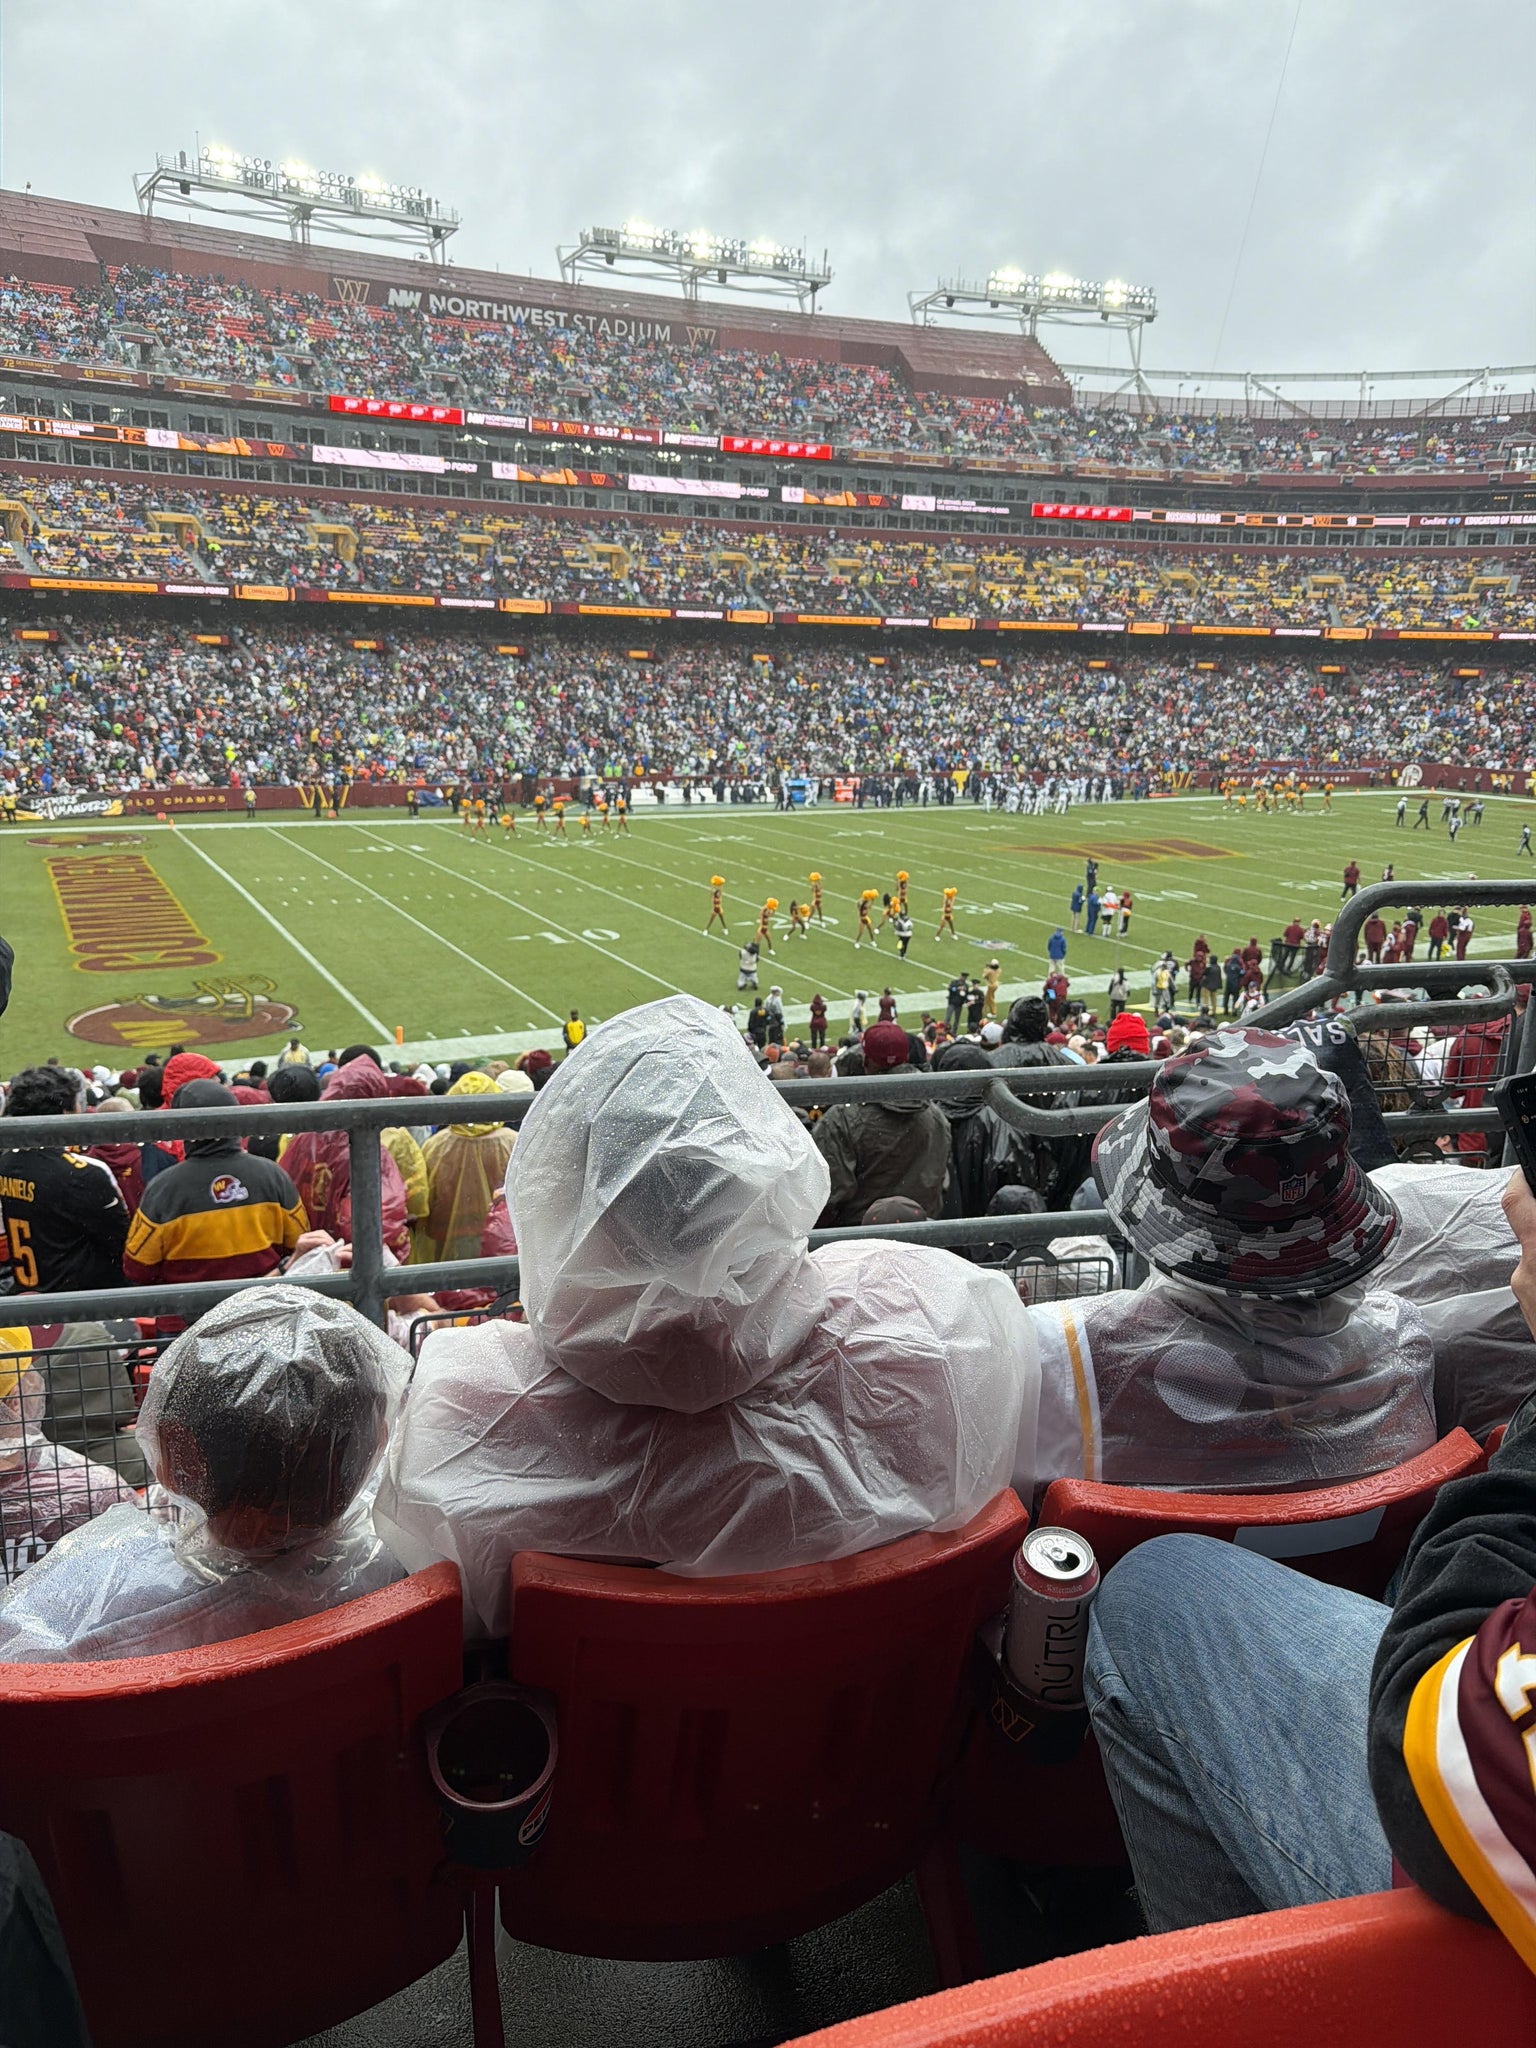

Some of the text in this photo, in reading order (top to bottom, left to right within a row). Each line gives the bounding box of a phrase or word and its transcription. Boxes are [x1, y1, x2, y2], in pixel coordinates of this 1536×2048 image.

[430, 293, 568, 328] NORTHWEST
[573, 313, 671, 341] STADIUM
[34, 420, 40, 431] 1
[1165, 511, 1221, 524] RUSHING YARDS
[163, 795, 226, 806] CHAMPS
[533, 928, 621, 945] 10
[1284, 1185, 1304, 1200] NFL
[8, 1218, 39, 1288] 5
